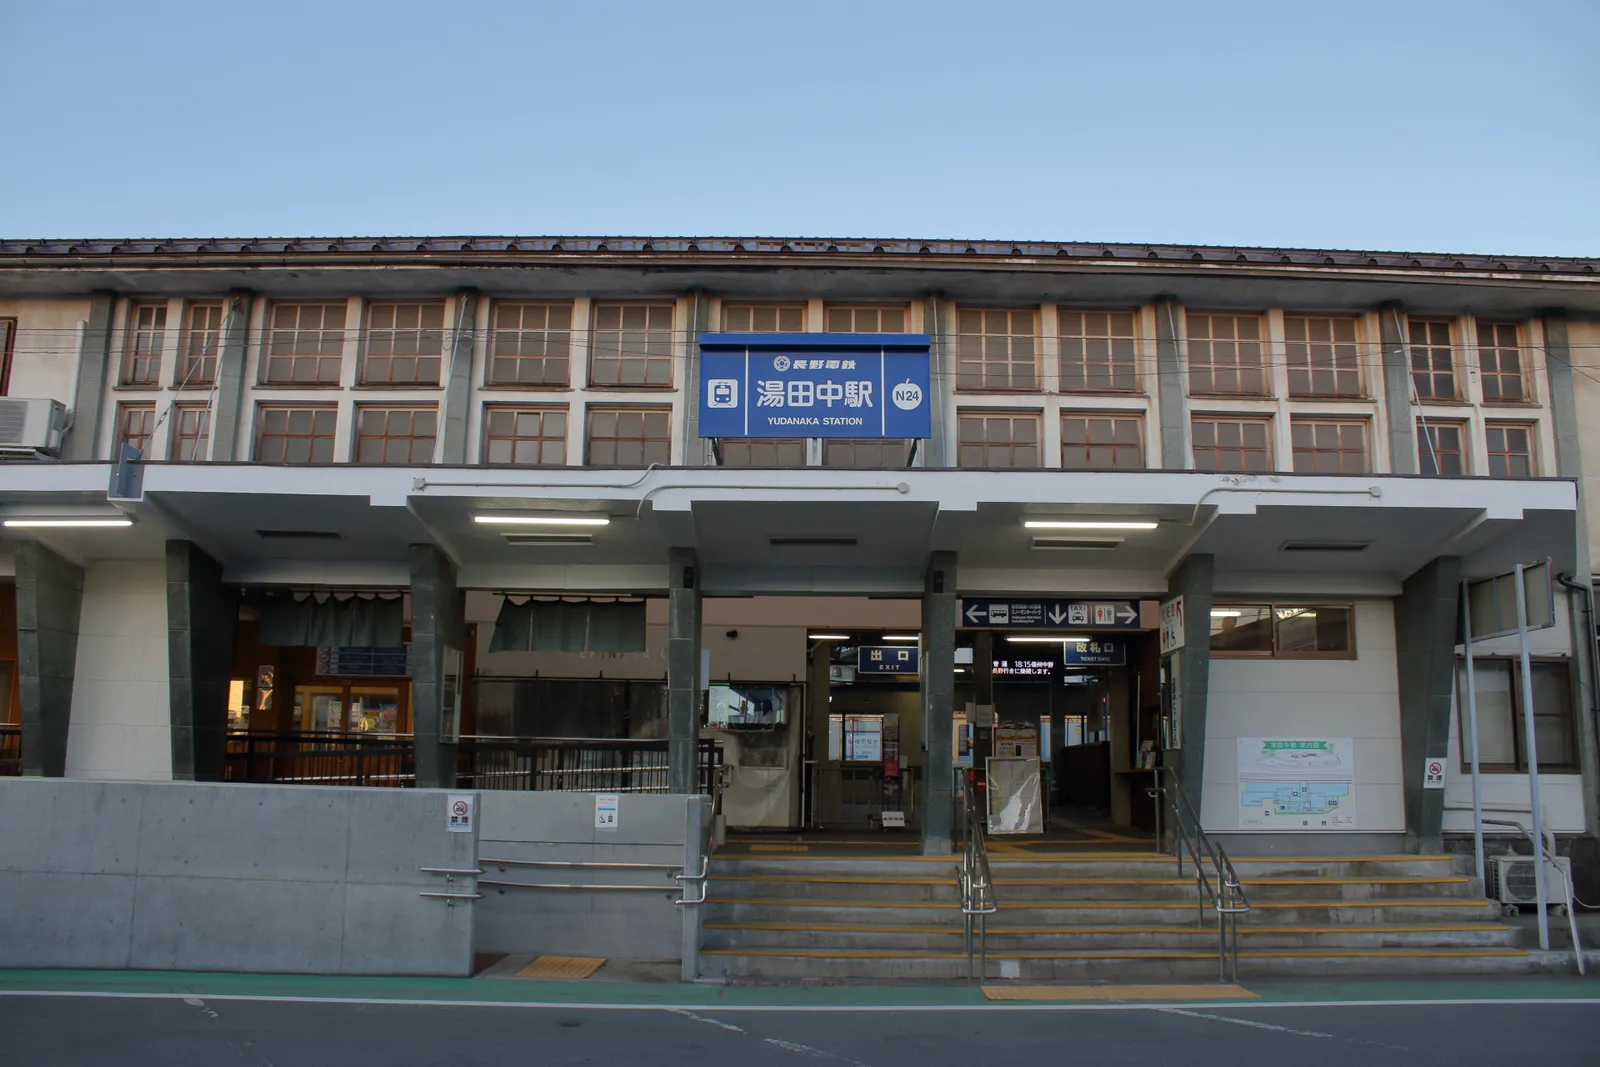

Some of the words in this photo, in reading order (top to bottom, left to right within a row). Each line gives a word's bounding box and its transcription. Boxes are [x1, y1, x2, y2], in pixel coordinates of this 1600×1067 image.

[793, 360, 856, 369] 長野電鉄
[757, 380, 873, 407] 湯田中駅
[896, 390, 919, 401] N24
[767, 417, 820, 425] YUDANAKA
[822, 417, 863, 425] STATION
[1076, 642, 1114, 653] 改札口
[871, 650, 908, 660] 出口
